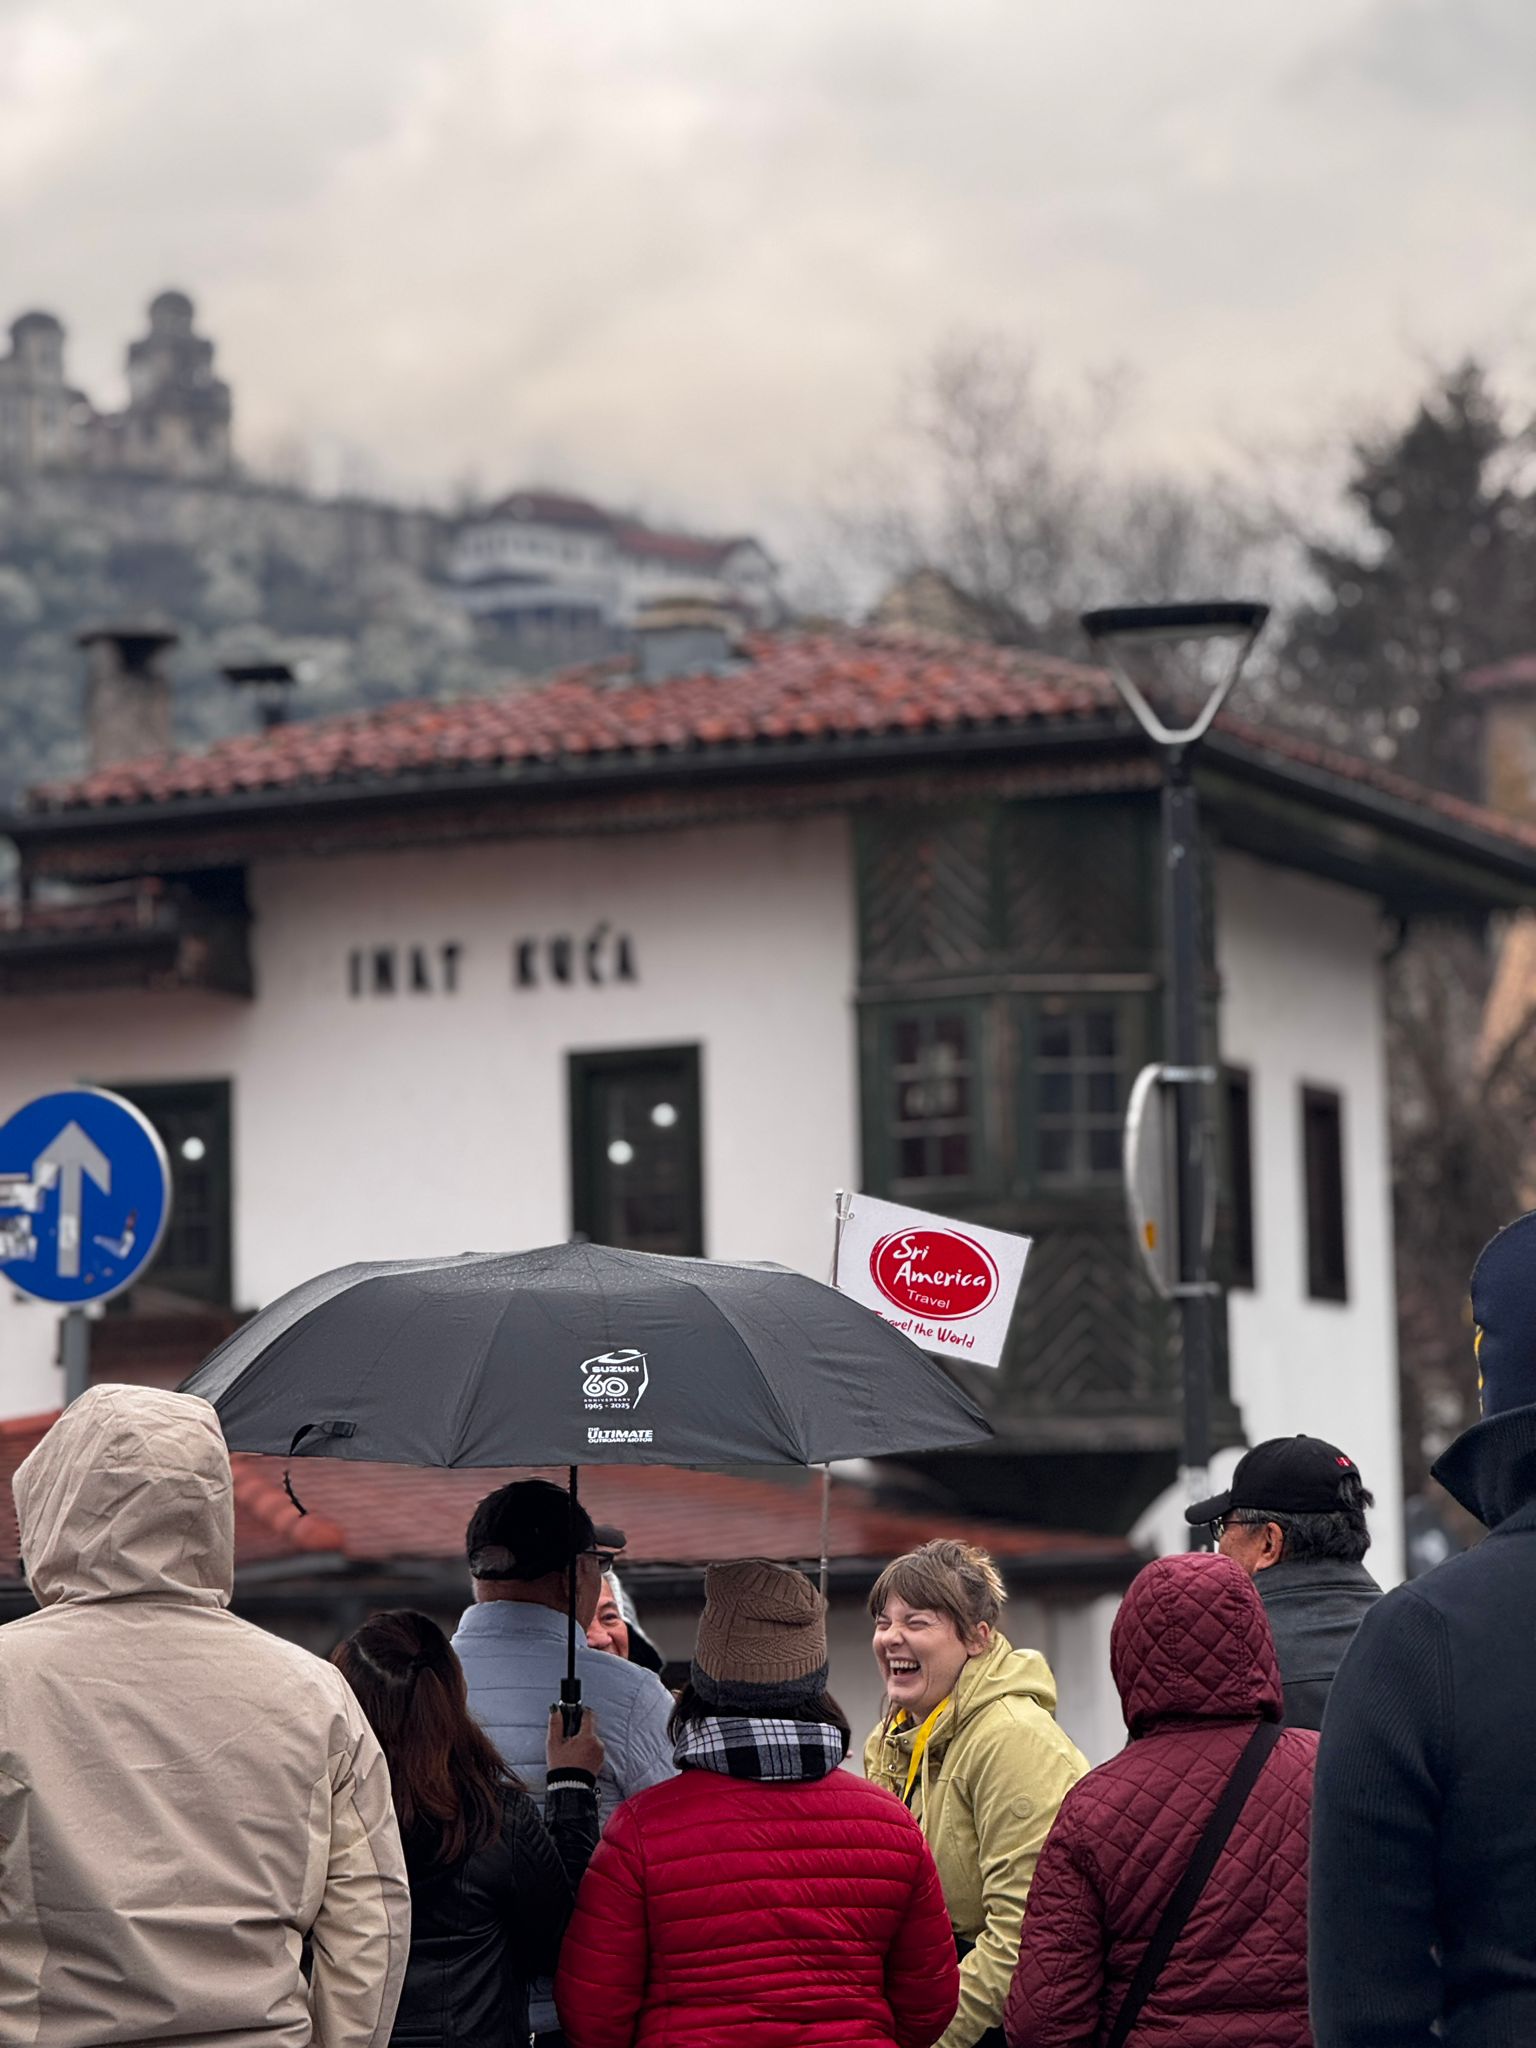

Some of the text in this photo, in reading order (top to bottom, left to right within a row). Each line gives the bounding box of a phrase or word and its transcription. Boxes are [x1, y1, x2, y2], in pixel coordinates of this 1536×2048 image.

[892, 1235, 930, 1261] Sri
[893, 1260, 986, 1288] America
[907, 1289, 950, 1310] Travel
[914, 1322, 933, 1337] the
[937, 1327, 975, 1349] World
[592, 1365, 639, 1373] SUZUKI
[582, 1374, 629, 1397] 60
[584, 1402, 603, 1410] 1965
[610, 1402, 630, 1410] 2025
[587, 1429, 653, 1439] ULTIMATE
